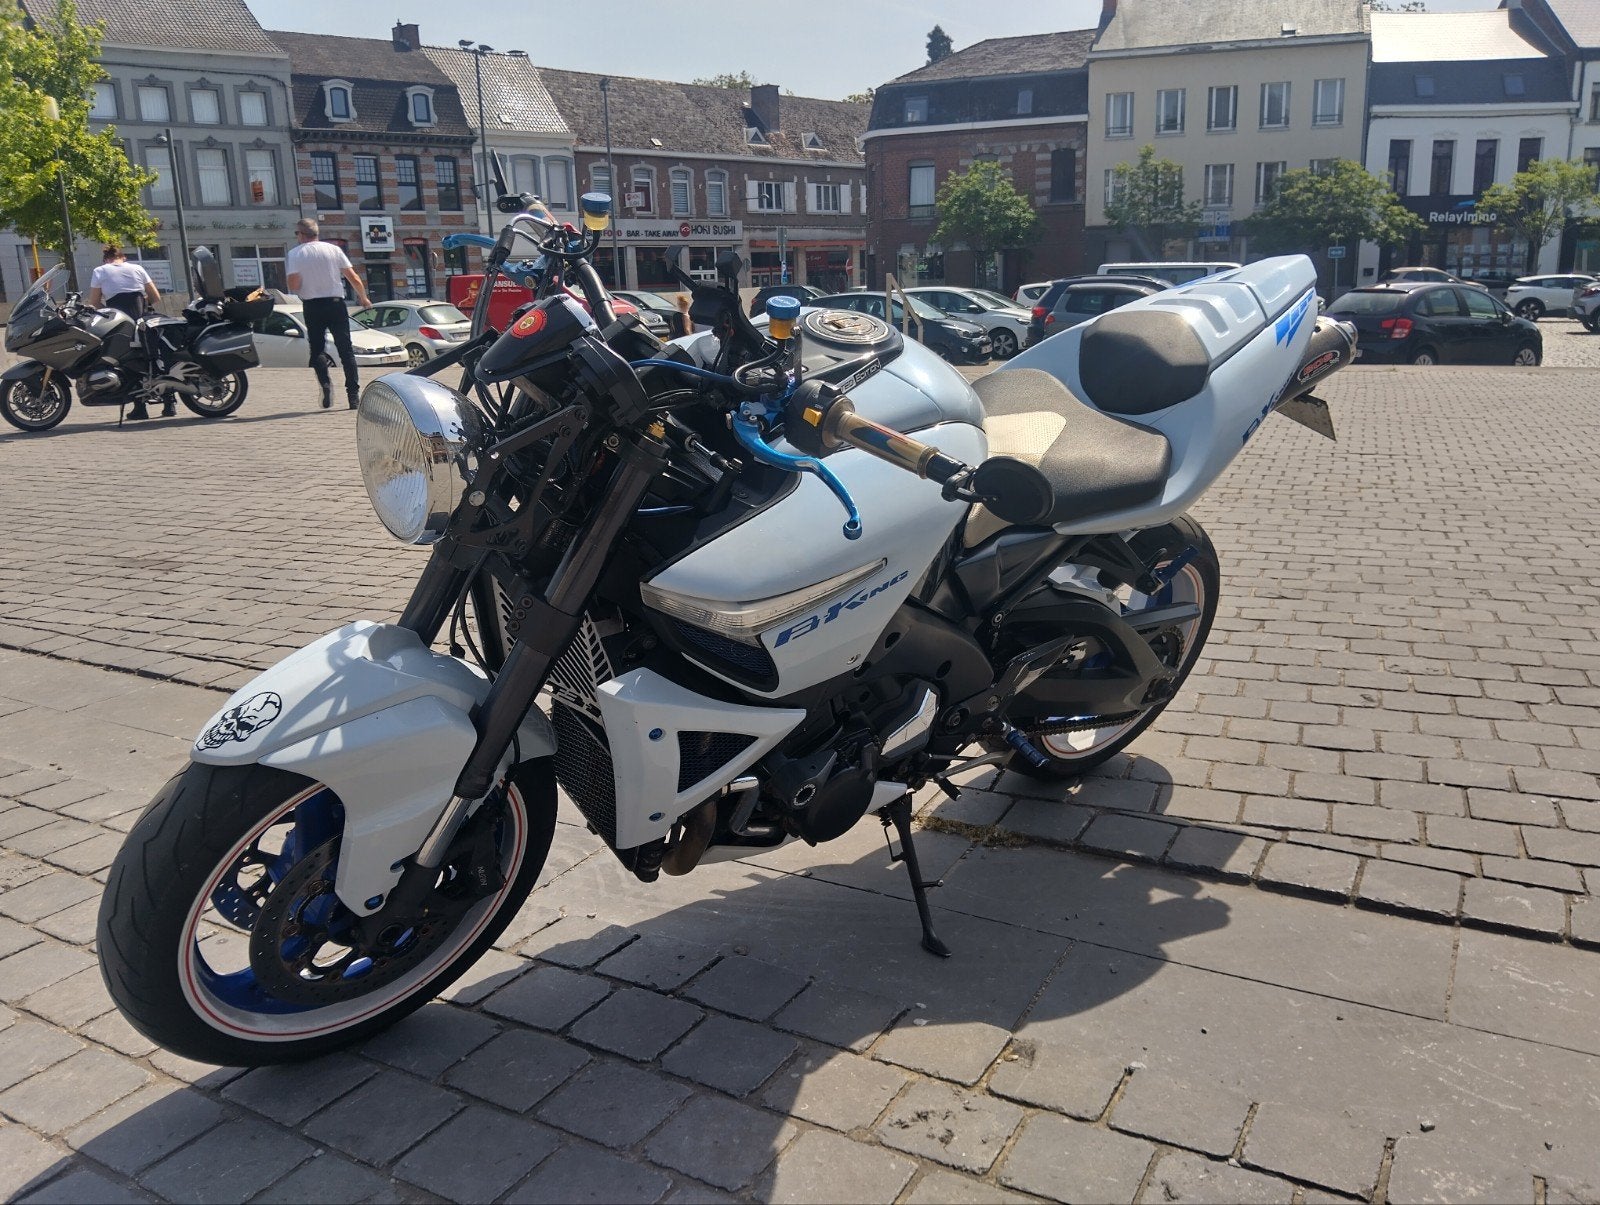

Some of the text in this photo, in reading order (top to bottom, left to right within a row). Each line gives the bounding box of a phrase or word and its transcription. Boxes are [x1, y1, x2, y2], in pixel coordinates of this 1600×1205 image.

[603, 229, 623, 237] FOD
[662, 230, 679, 238] AWAY
[691, 225, 736, 235] HOKI SUSHI
